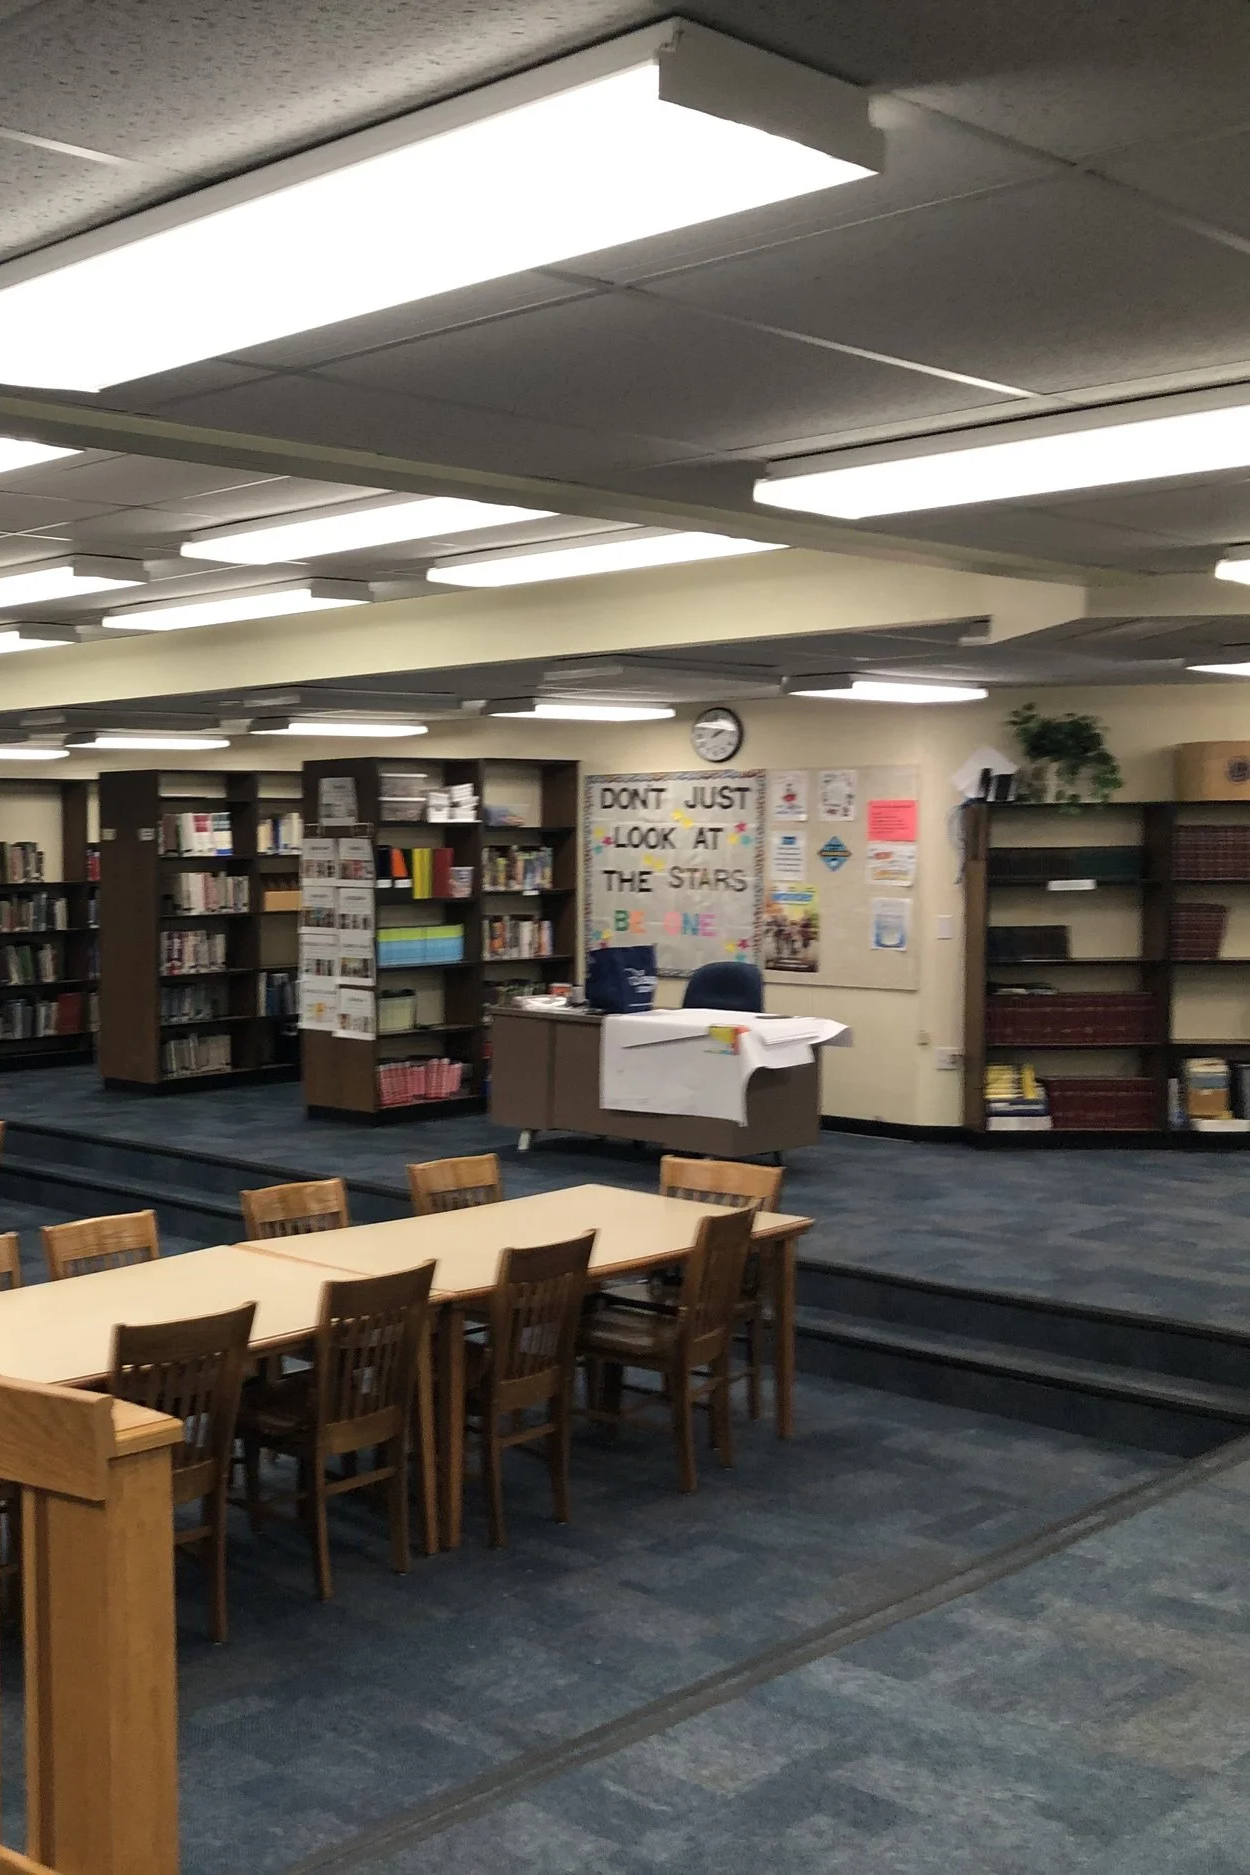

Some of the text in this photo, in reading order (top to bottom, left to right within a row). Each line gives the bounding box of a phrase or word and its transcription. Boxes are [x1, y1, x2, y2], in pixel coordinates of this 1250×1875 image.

[684, 785, 750, 810] JUST
[614, 826, 724, 850] LOOK AT
[602, 866, 747, 893] THE STARS
[614, 909, 717, 938] BE ONE
